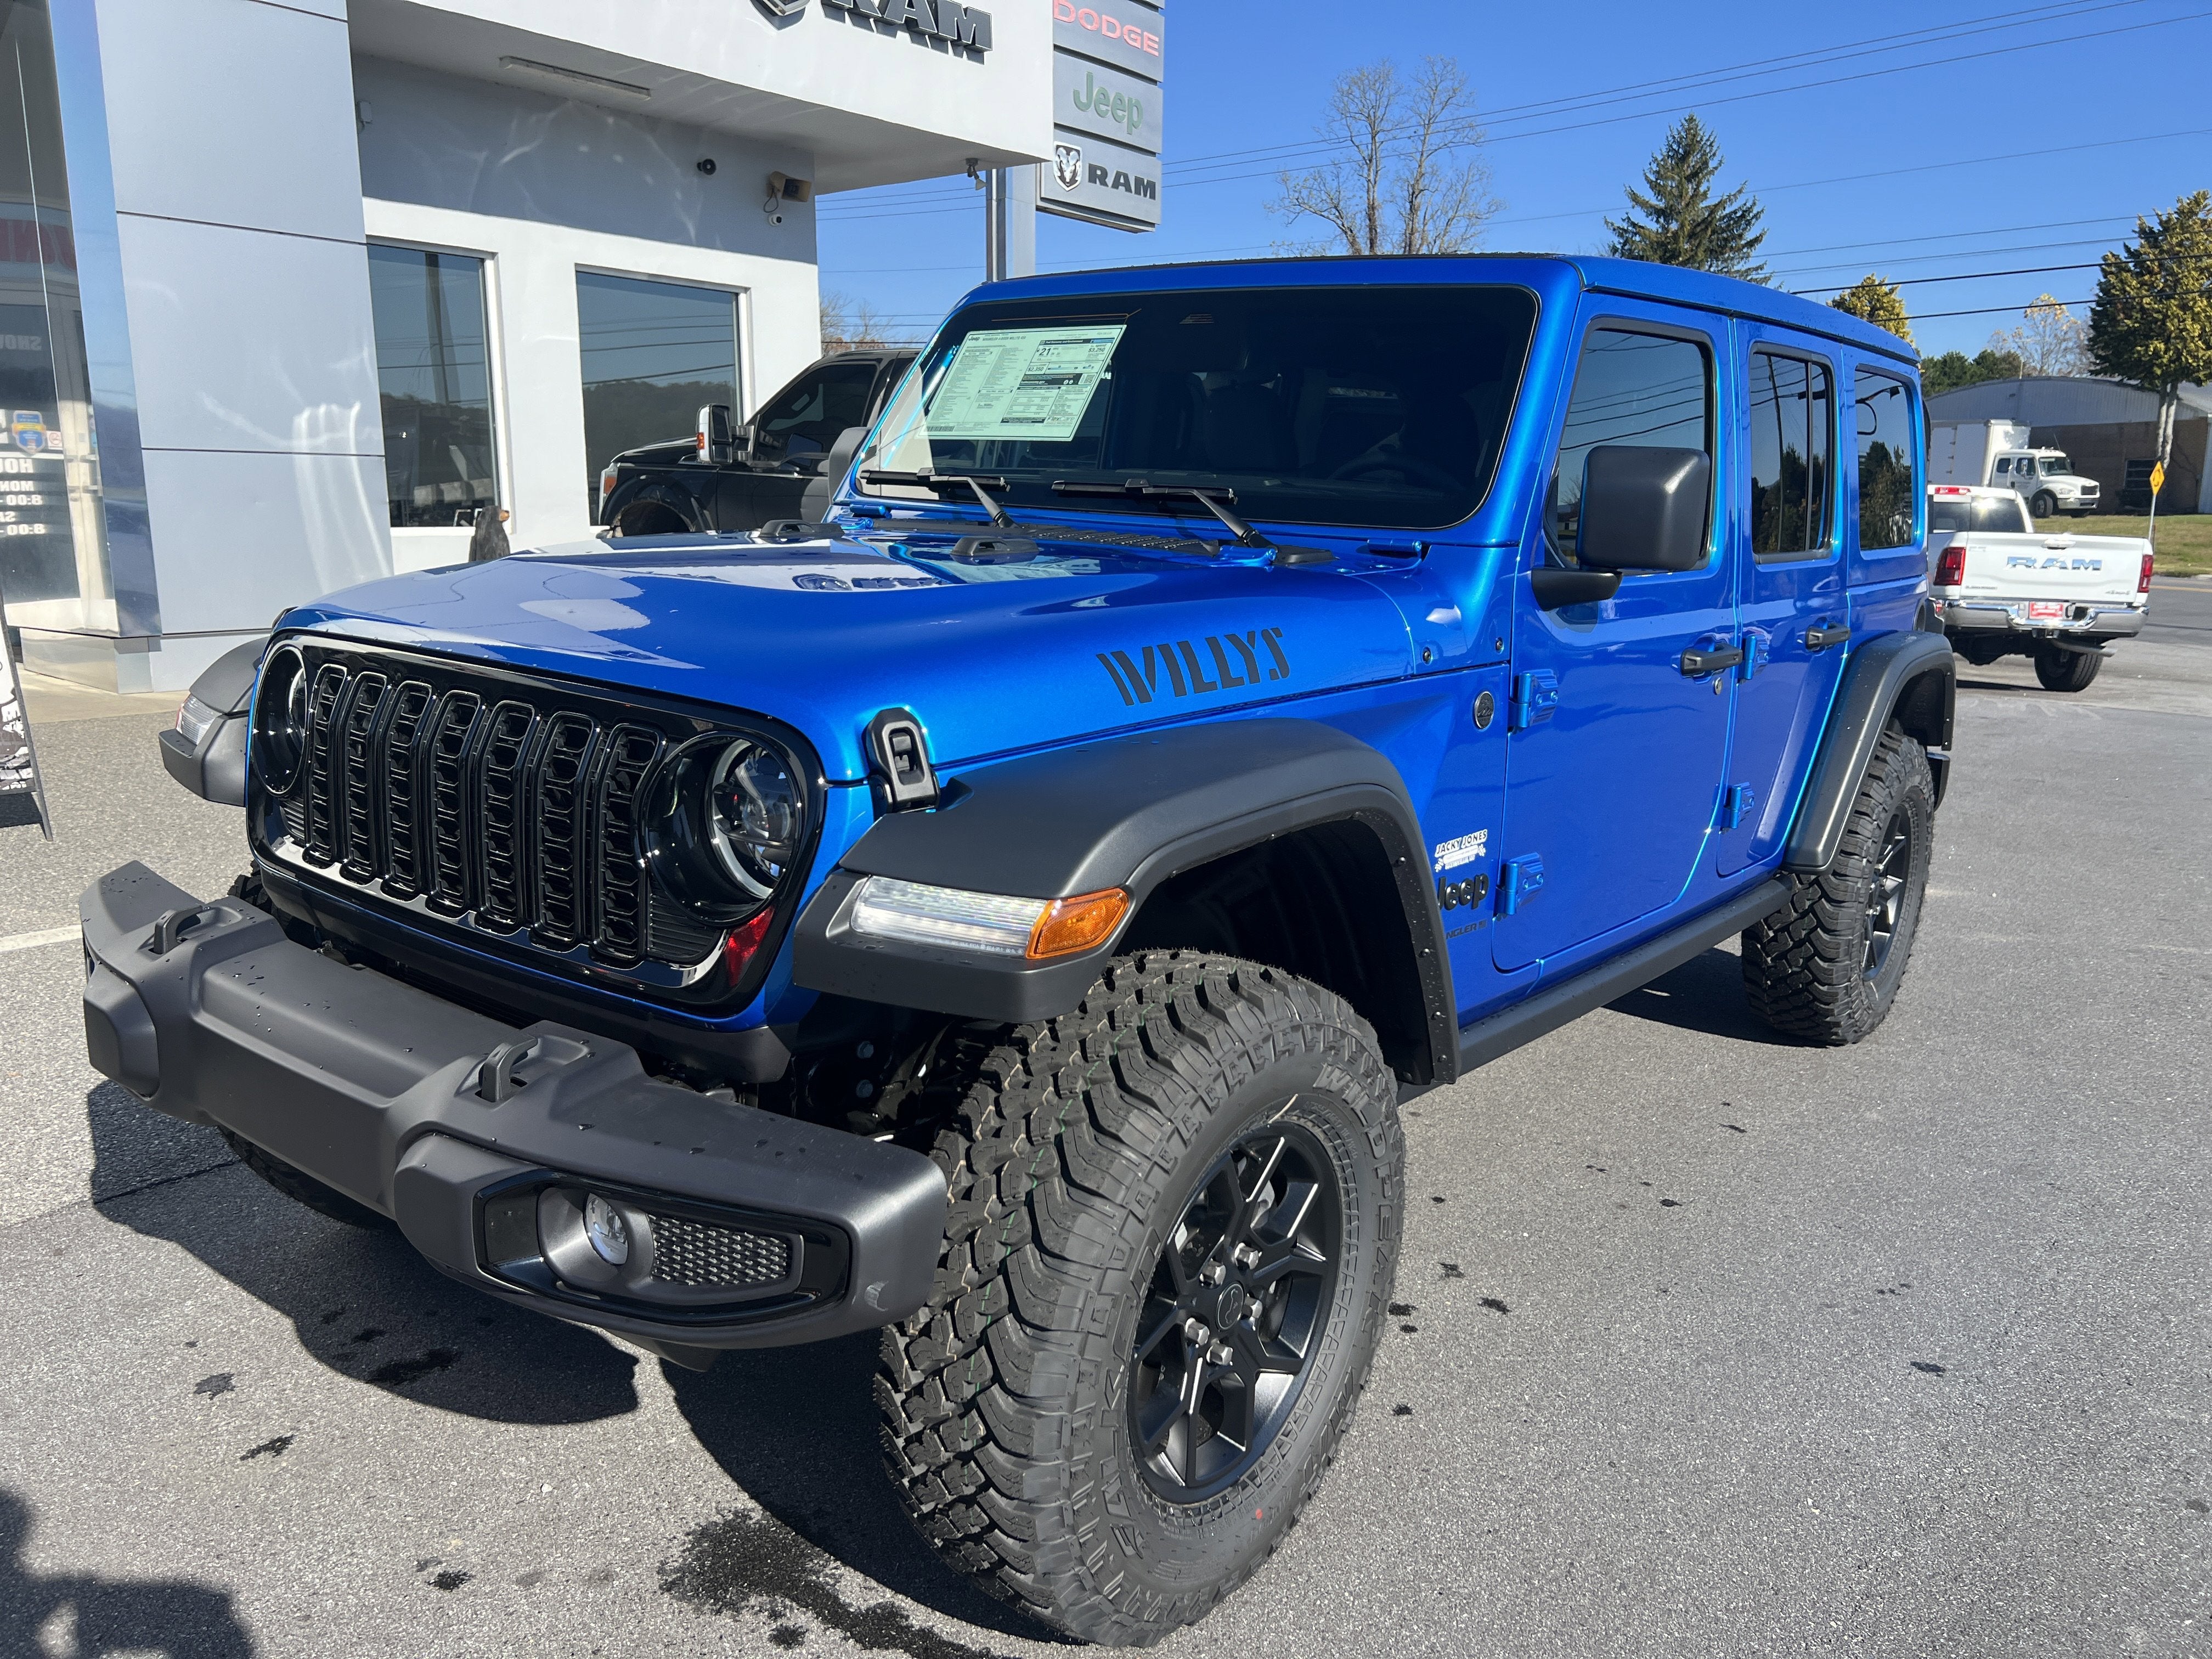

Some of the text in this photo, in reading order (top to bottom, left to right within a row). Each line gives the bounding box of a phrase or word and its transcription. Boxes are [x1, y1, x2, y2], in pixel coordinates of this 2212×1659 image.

[1053, 0, 1159, 57] DODGE
[1073, 71, 1143, 135] Jeep
[1088, 163, 1156, 200] RAM
[1039, 348, 1051, 356] 21
[2007, 556, 2102, 571] RAM
[1096, 627, 1290, 707] WILLYS
[1437, 839, 1461, 855] JACKY
[1463, 830, 1487, 846] JONES
[1437, 873, 1489, 911] Jeep
[1446, 923, 1477, 939] NGLER
[1313, 1062, 1393, 1344] WILDPEAK
[1099, 1227, 1160, 1559] FALKEN
